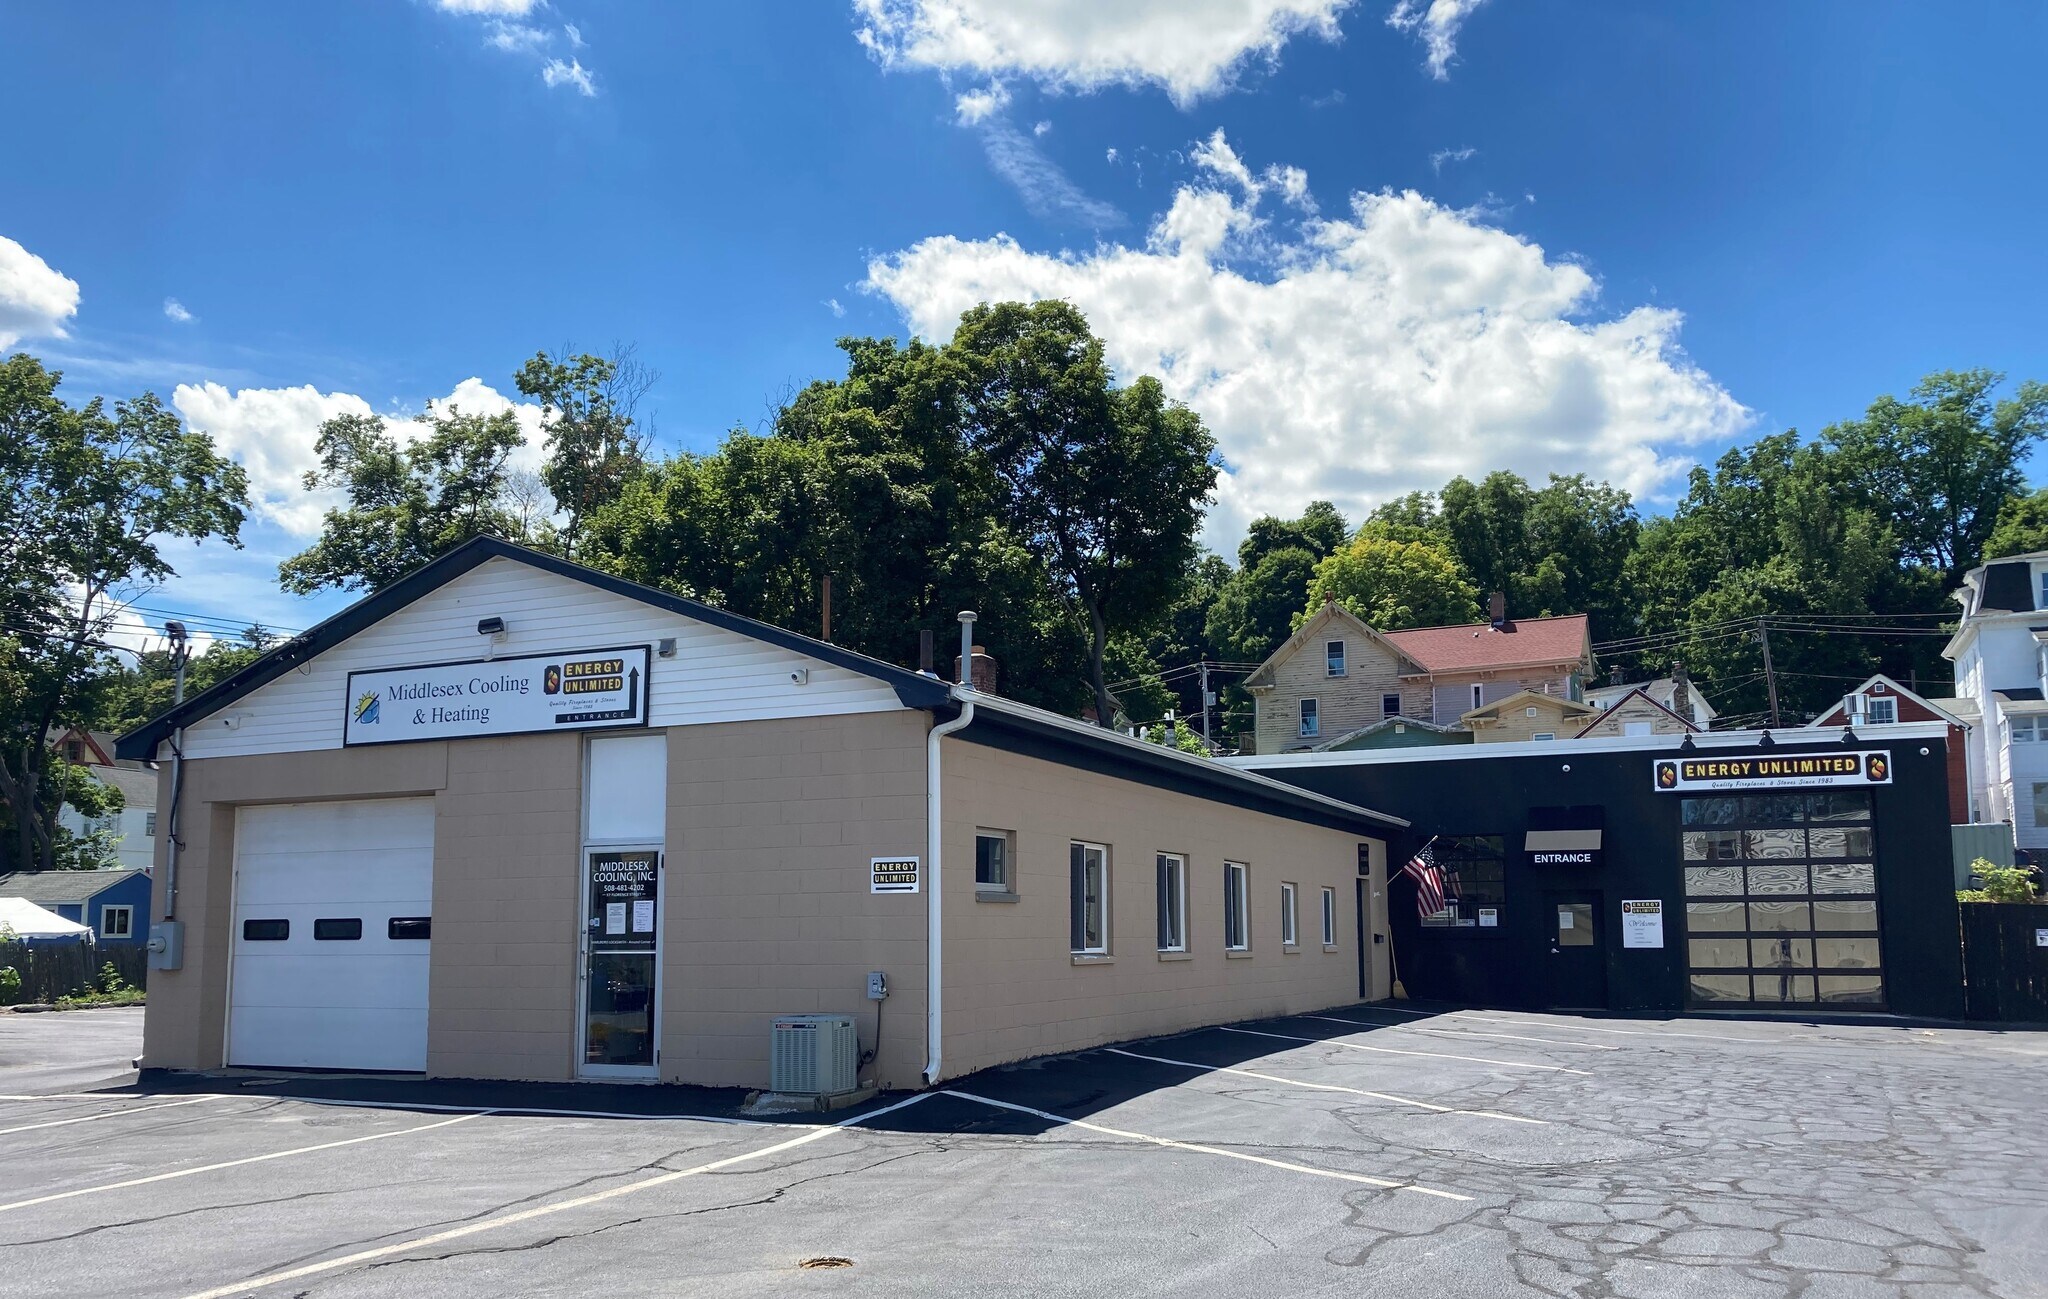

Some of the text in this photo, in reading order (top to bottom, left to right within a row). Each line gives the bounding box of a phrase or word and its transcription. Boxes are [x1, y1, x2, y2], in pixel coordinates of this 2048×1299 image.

[566, 661, 621, 676] ENERGY
[388, 675, 530, 701] Middlesex Cooling
[565, 678, 621, 692] UNLIMITED
[412, 704, 490, 725] & Heating
[567, 712, 625, 721] ENTRANCE
[1686, 759, 1855, 777] ENERGY UNLIMITED
[1534, 853, 1591, 863] ENTRANCE
[600, 861, 650, 871] MIDDLESEX
[875, 863, 915, 871] ENERGY
[593, 871, 656, 882] COOLING, INC.
[604, 884, 645, 892] 508-481-4202
